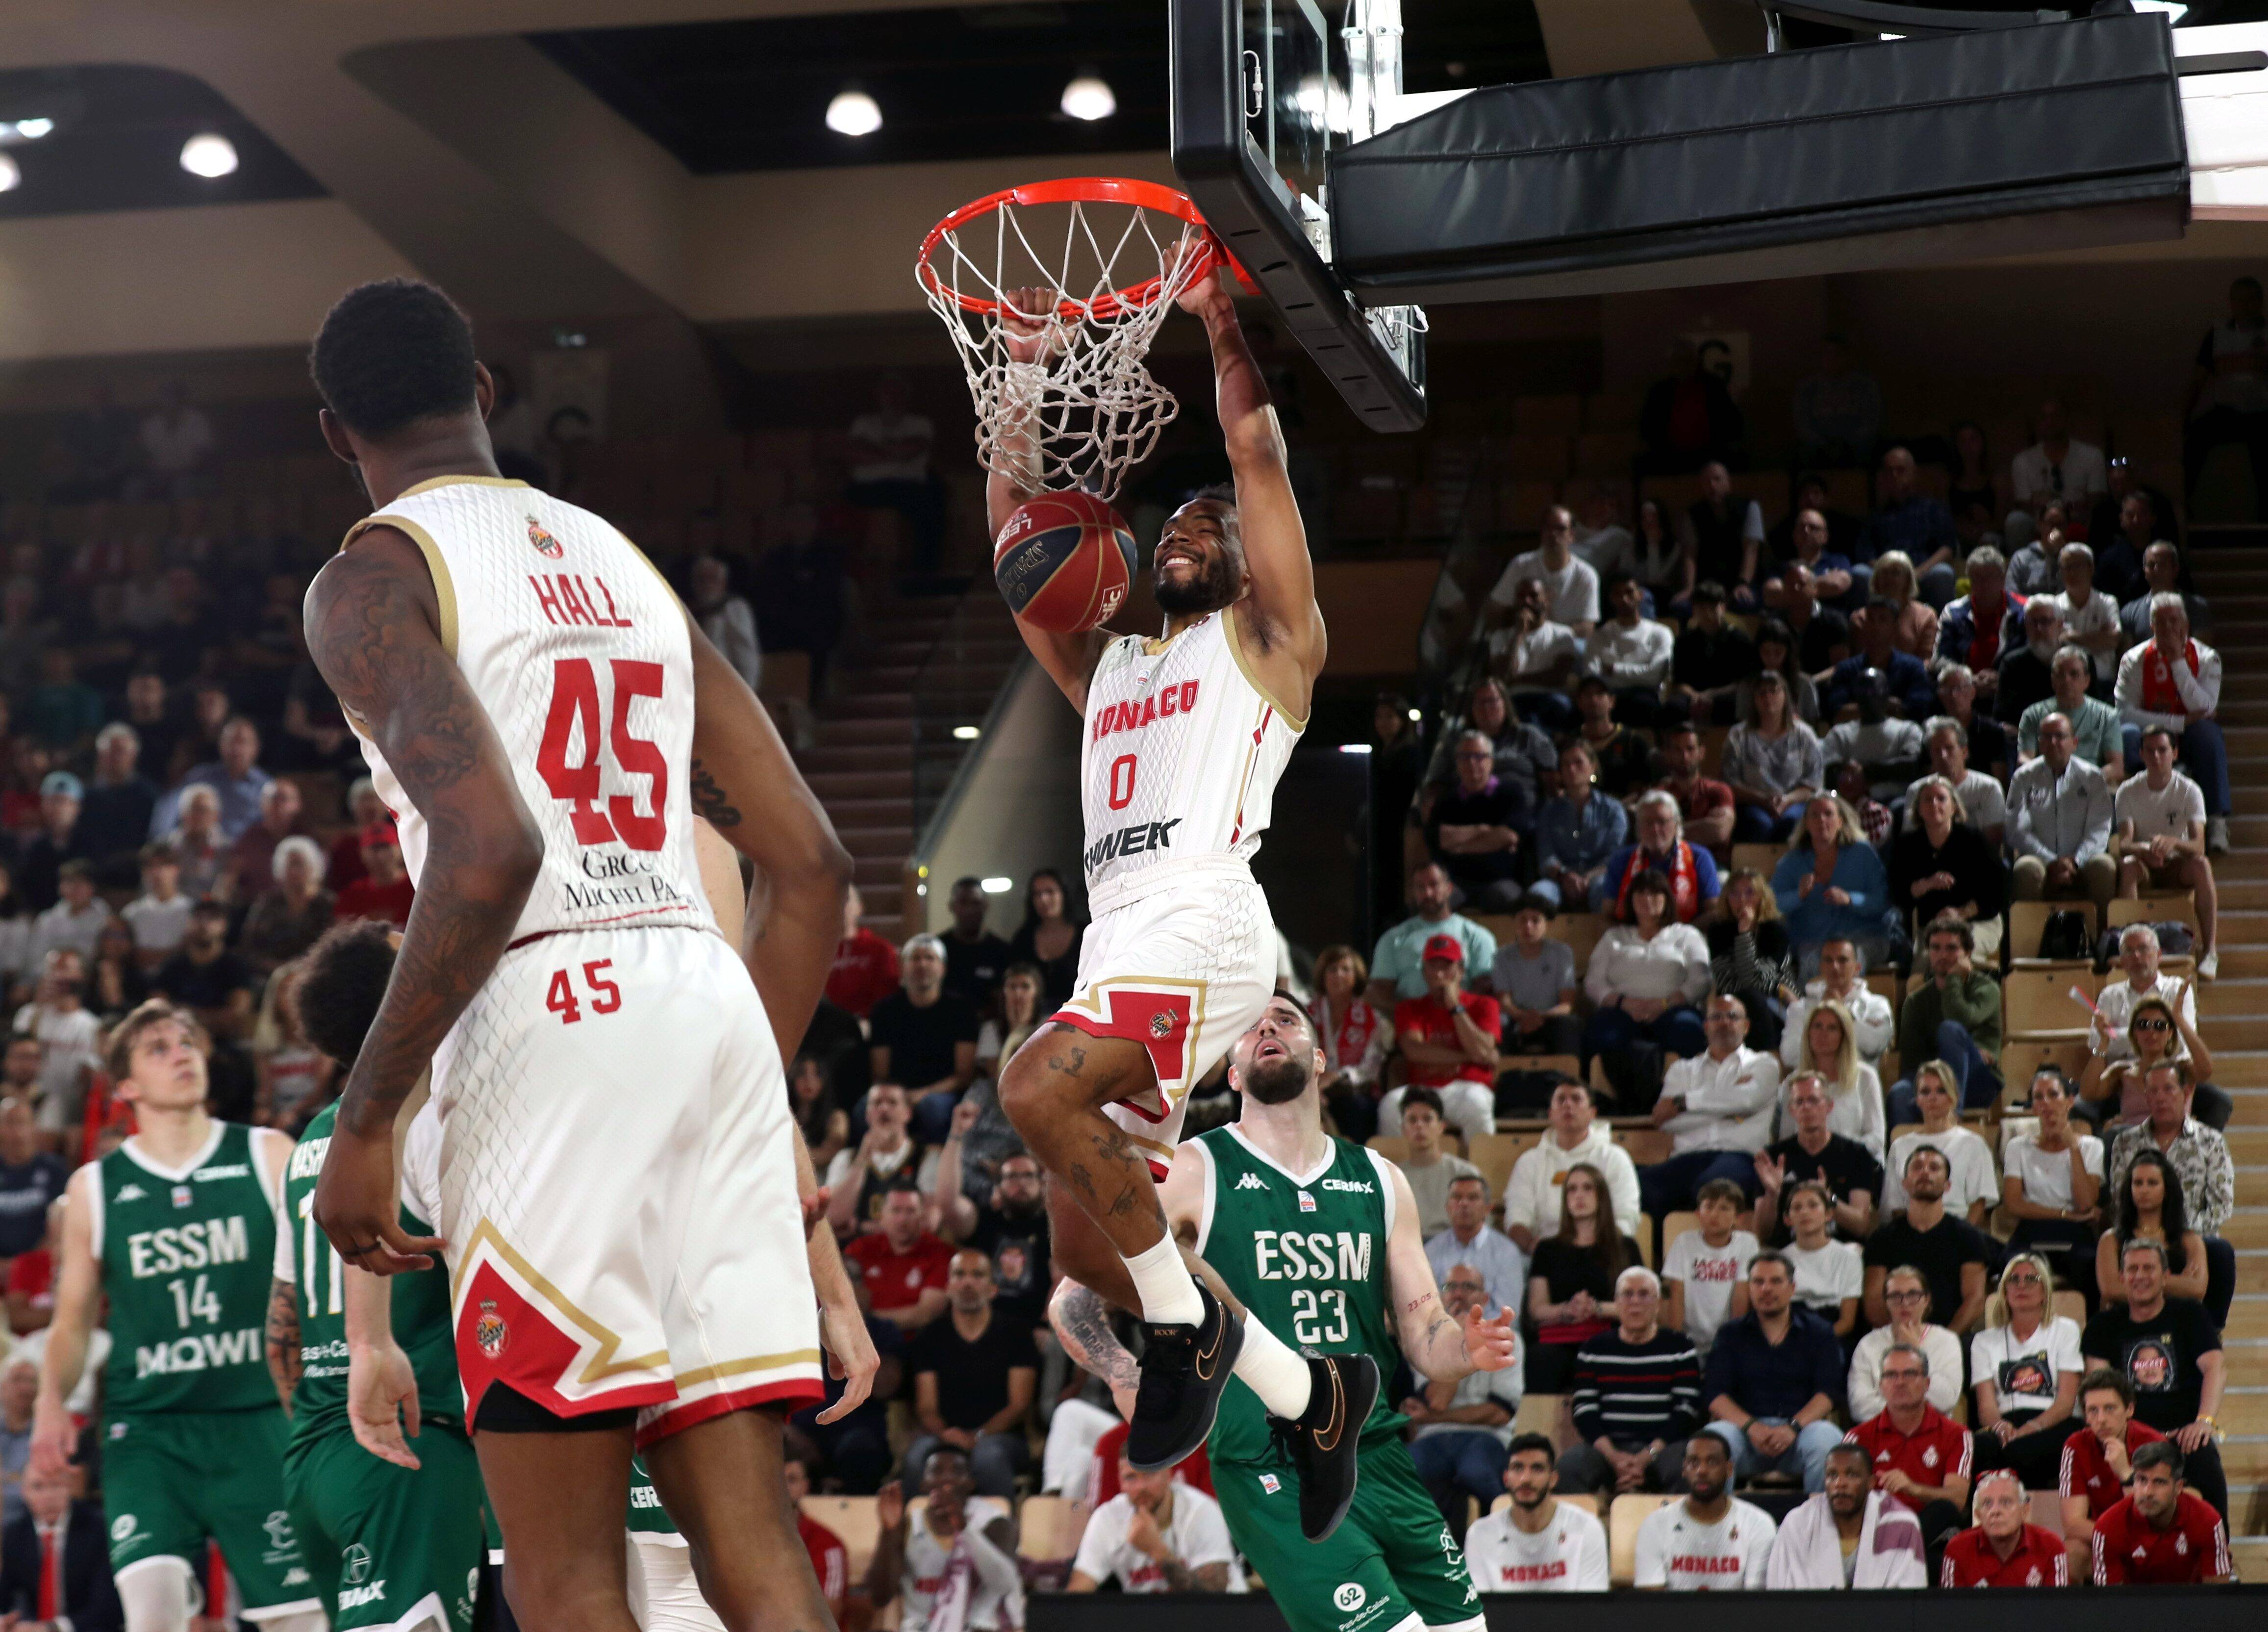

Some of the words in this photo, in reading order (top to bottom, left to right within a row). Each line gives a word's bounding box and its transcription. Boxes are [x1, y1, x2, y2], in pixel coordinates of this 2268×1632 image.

[529, 574, 632, 627] HALL
[536, 658, 668, 852] 45
[1109, 753, 1137, 811] 0
[546, 958, 621, 1024] 45
[127, 1215, 249, 1278] ESSM
[1254, 1230, 1371, 1282] ESSM
[167, 1274, 222, 1329] 14
[1291, 1289, 1349, 1344] 23
[1671, 1555, 1739, 1574] MONACO
[1340, 1587, 1361, 1606] 62
